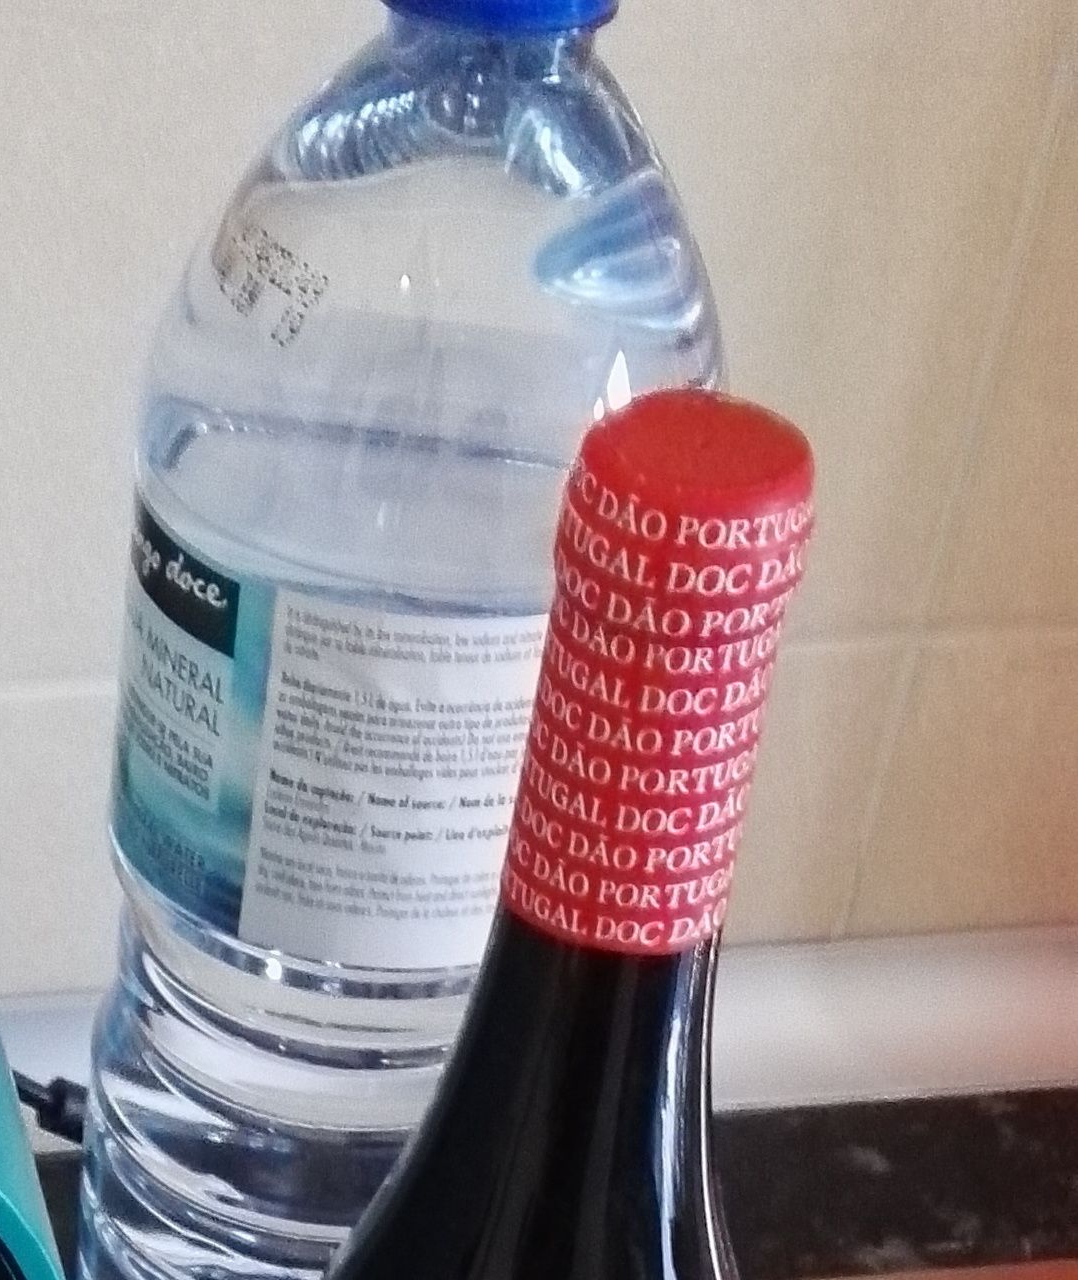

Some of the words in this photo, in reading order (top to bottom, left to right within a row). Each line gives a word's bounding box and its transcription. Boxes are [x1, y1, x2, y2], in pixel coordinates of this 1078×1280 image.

[598, 486, 668, 542] DÃO
[165, 552, 228, 609] doce
[667, 561, 753, 597] DOC
[607, 591, 691, 638] DÃO
[141, 653, 220, 738] NATURAL
[640, 685, 718, 716] DOC
[588, 711, 663, 755] DÃO
[551, 733, 612, 784] DÃO
[619, 746, 756, 795] PORTUG
[615, 803, 692, 835] DOC
[568, 830, 637, 870] DÃO
[533, 852, 590, 898] DÃO
[598, 864, 733, 910] PORTUG
[595, 914, 665, 947] DOC
